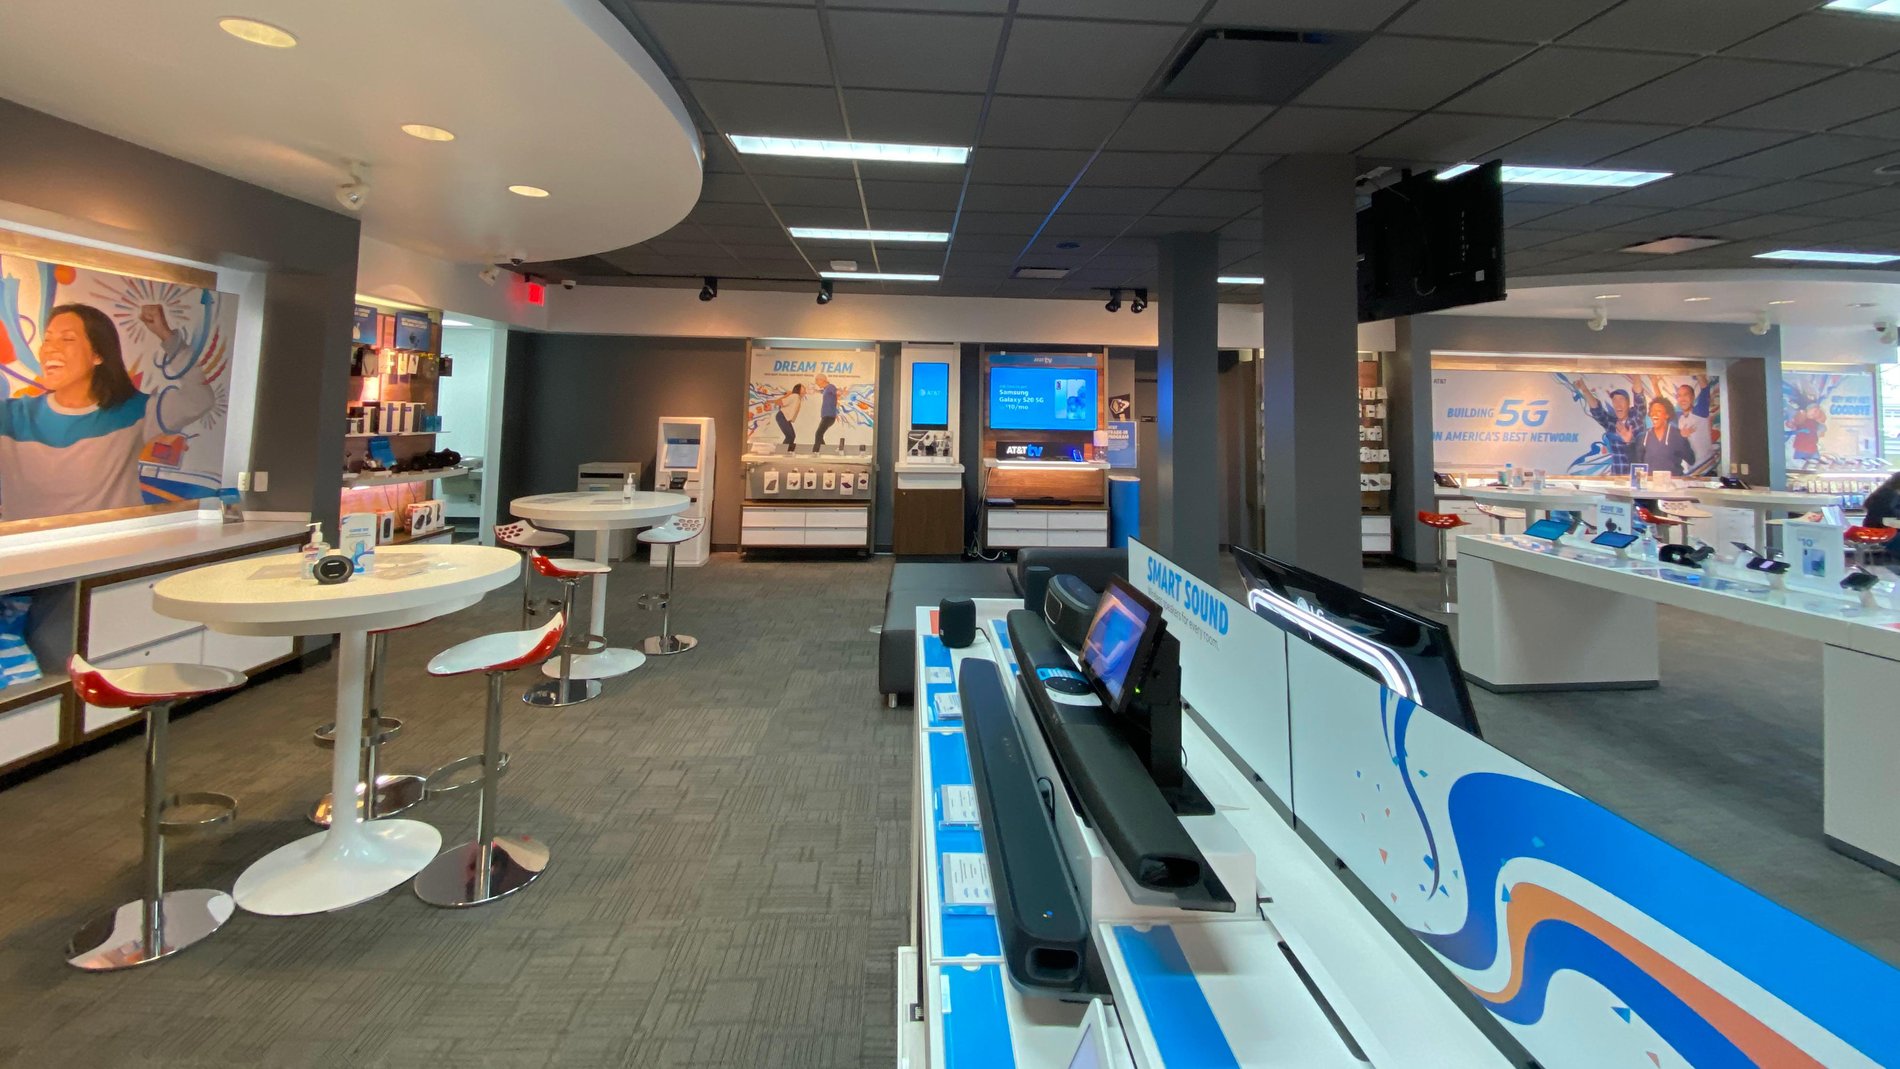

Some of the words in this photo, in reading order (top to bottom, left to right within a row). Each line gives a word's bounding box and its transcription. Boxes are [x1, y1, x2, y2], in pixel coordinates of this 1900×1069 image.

[773, 360, 817, 373] DREAM
[820, 361, 853, 374] TEAM
[999, 389, 1029, 397] Samsung
[1447, 408, 1495, 418] BUILDING
[1496, 400, 1550, 427] 5G
[1445, 432, 1500, 441] AMERICA'S
[1503, 432, 1529, 442] BEST
[1530, 433, 1579, 443] NETWORK
[1006, 446, 1028, 455] AT&T
[1027, 444, 1044, 457] tv
[1147, 555, 1182, 602] SMART
[1184, 580, 1229, 636] SOUND
[1188, 620, 1203, 641] every
